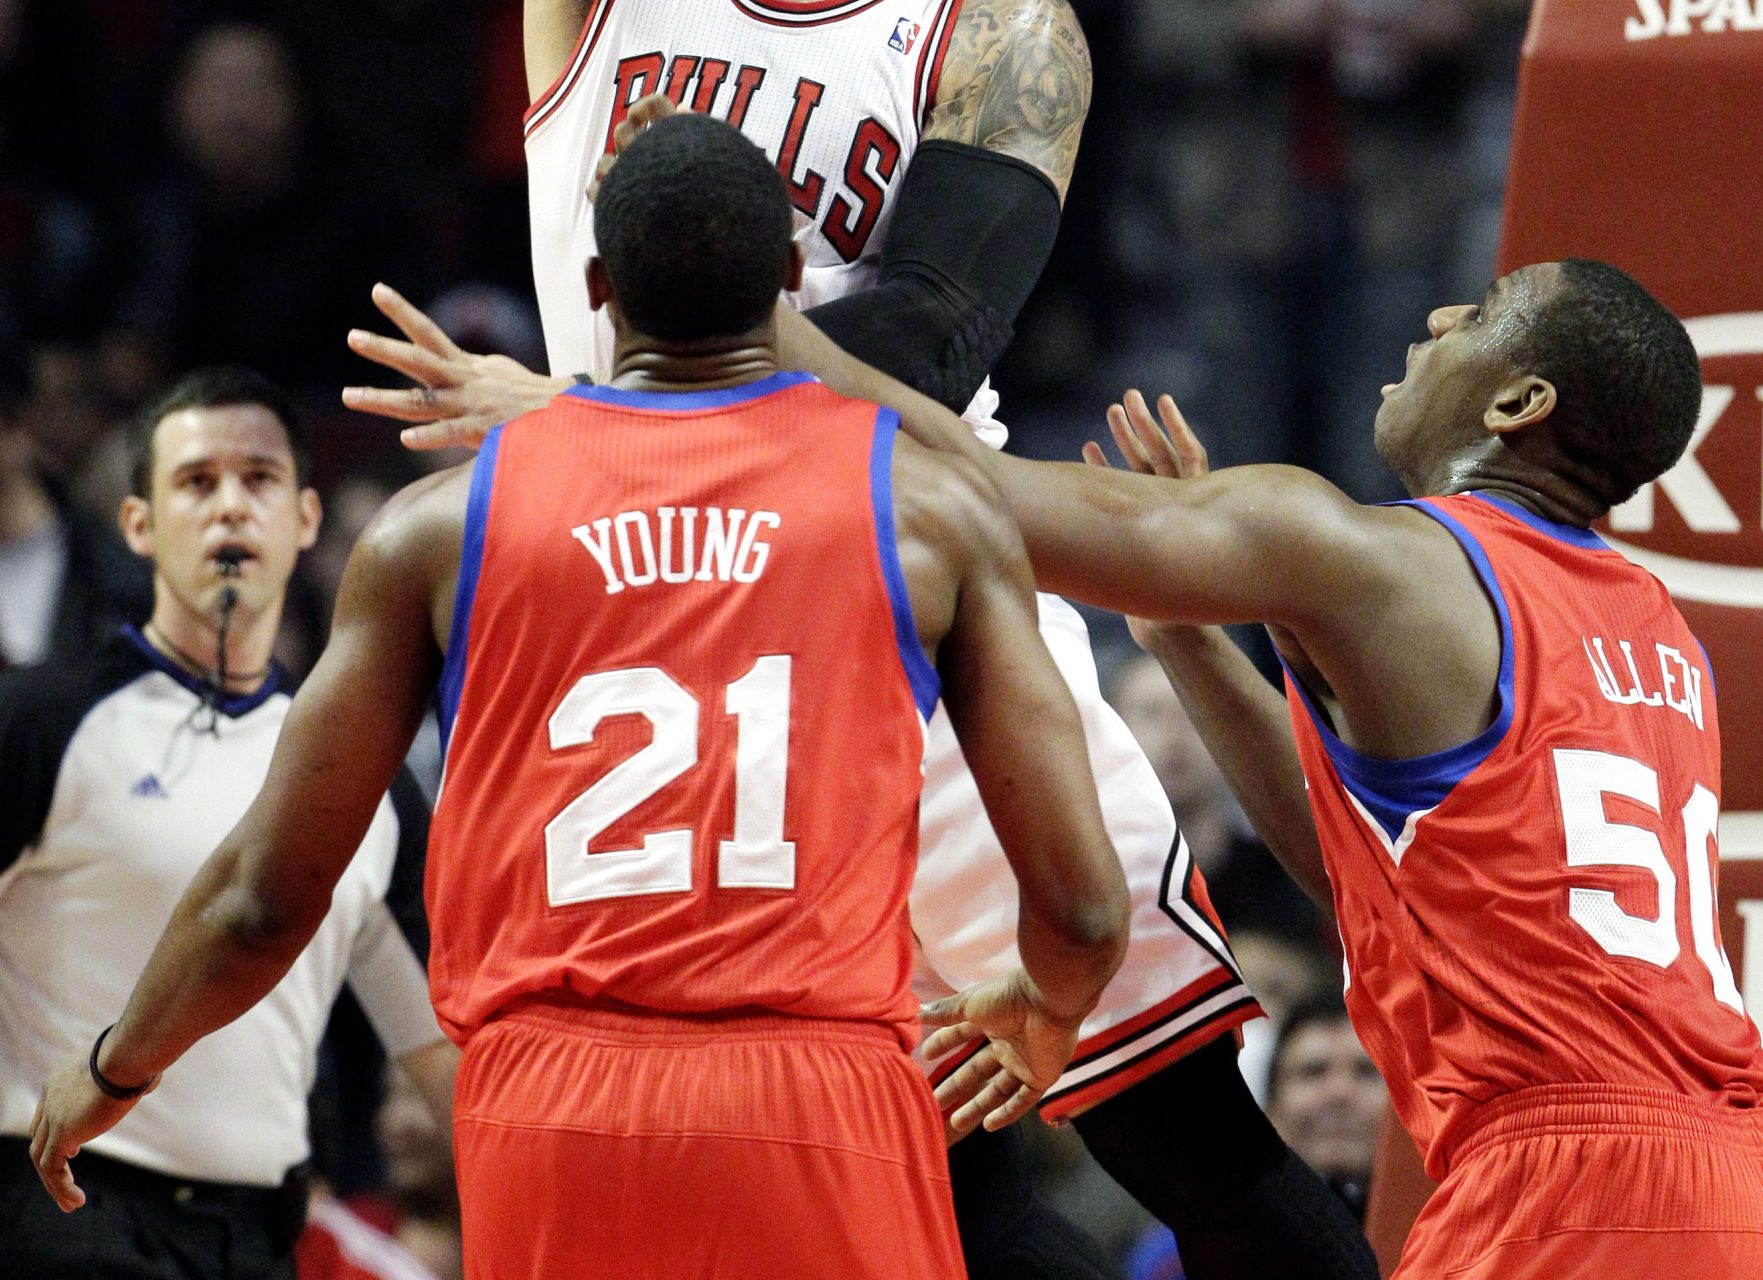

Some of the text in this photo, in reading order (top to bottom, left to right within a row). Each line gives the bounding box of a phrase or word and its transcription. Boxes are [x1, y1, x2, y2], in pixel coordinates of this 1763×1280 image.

[571, 506, 781, 595] YOUNG
[544, 654, 796, 908] 21
[1552, 748, 1745, 1018] 50
